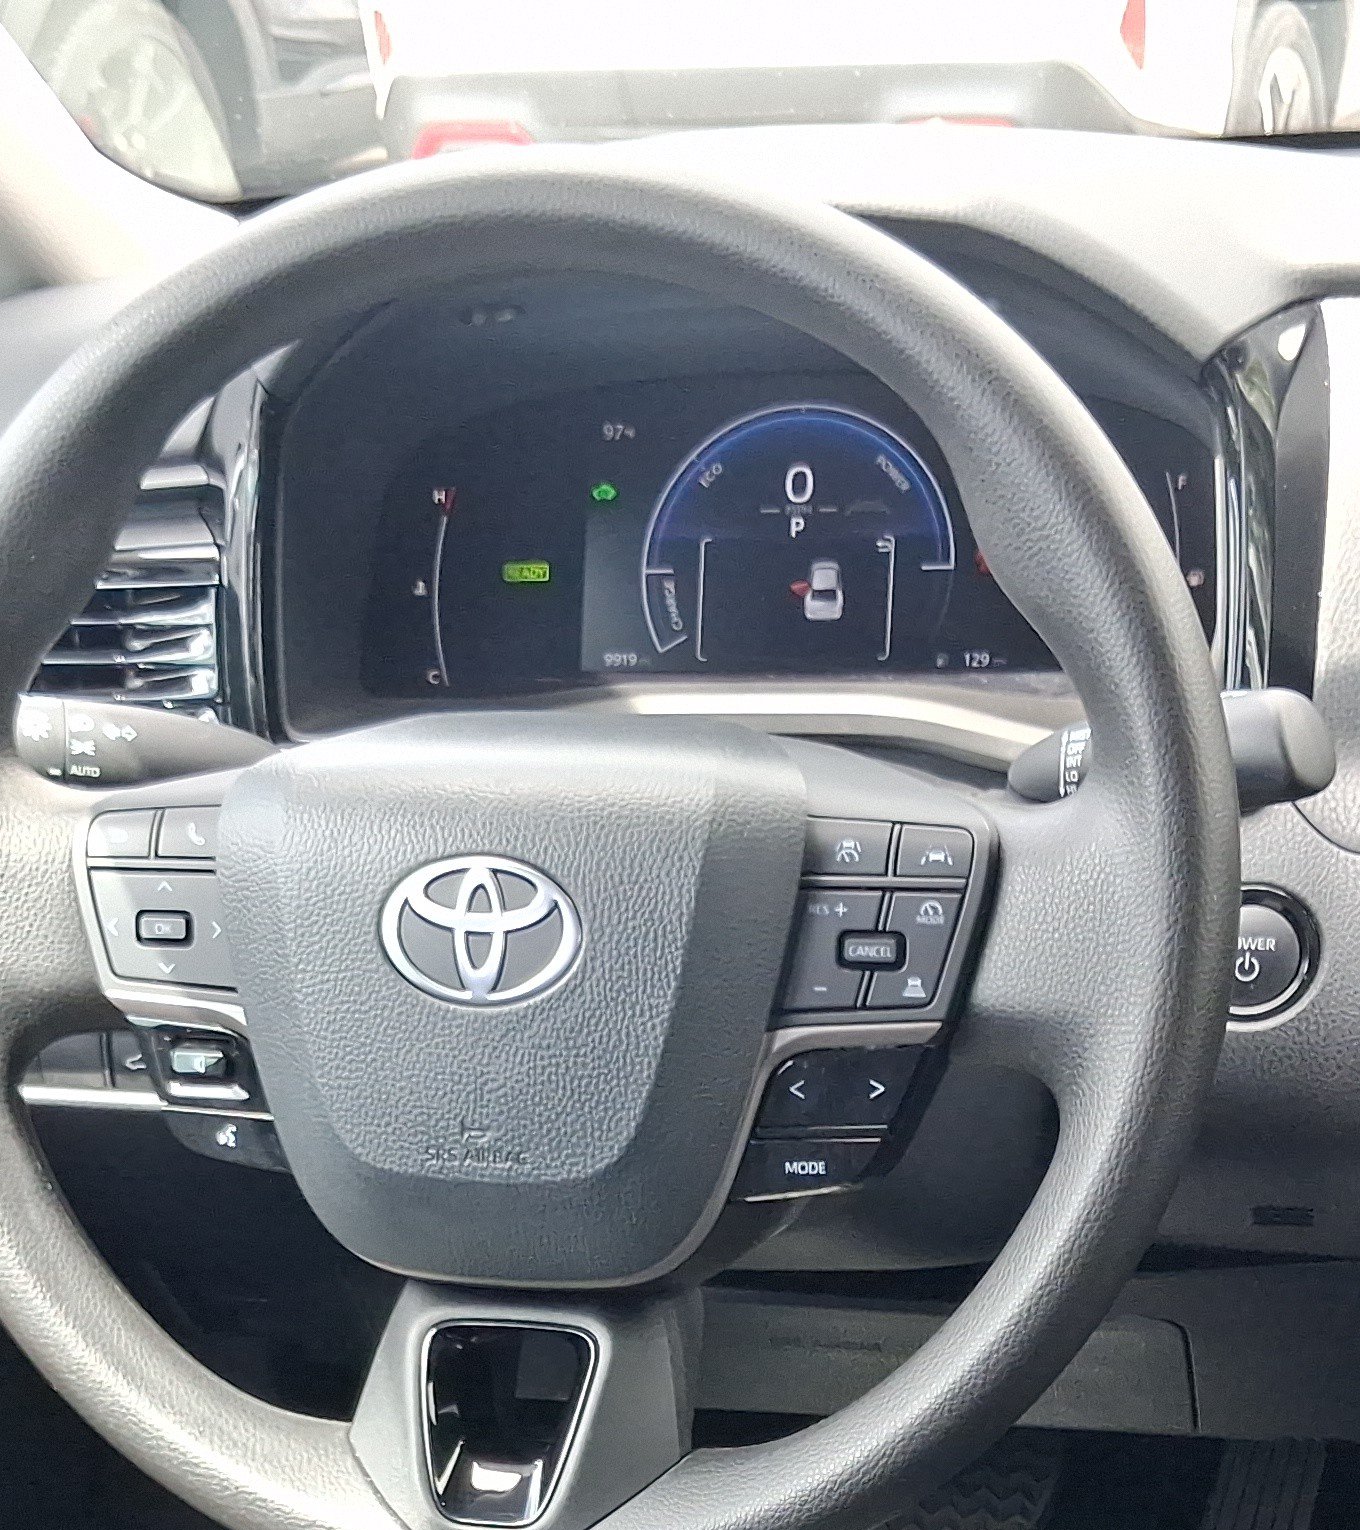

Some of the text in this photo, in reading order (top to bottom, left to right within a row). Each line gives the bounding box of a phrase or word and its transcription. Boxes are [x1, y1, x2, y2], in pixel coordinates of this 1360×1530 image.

[785, 463, 814, 504] 0
[432, 488, 446, 504] H
[790, 517, 805, 539] P
[963, 652, 990, 668] 129
[70, 763, 101, 778] AUTO
[848, 945, 892, 958] CANCEL
[784, 1161, 827, 1176] MODE
